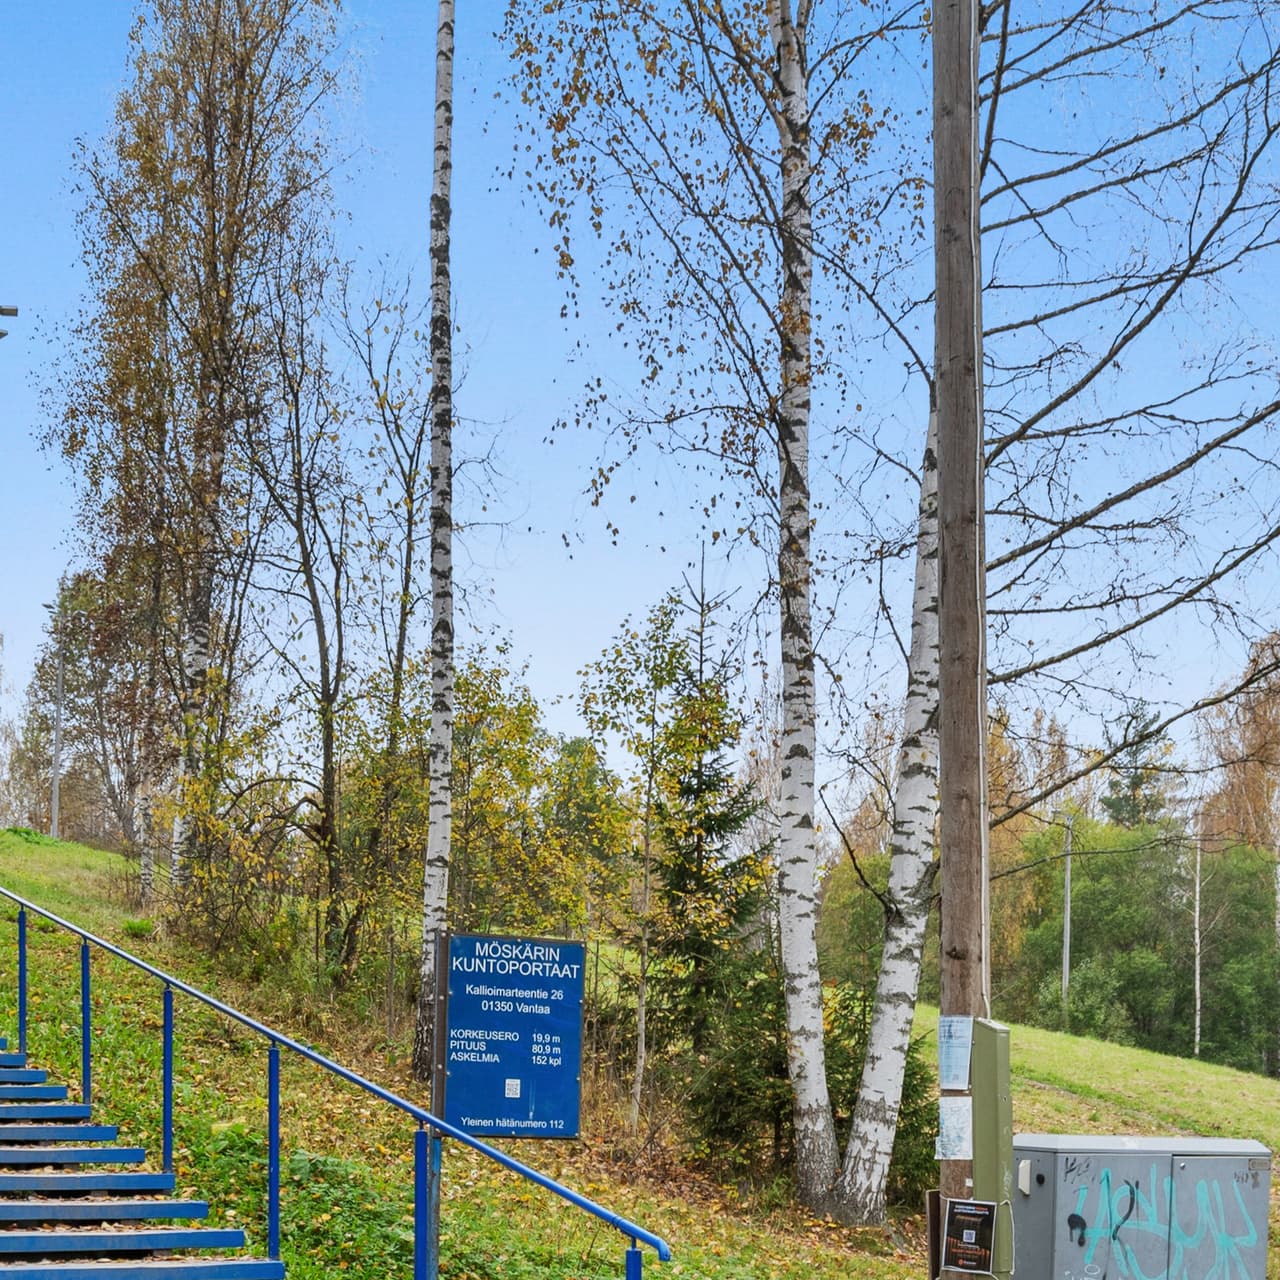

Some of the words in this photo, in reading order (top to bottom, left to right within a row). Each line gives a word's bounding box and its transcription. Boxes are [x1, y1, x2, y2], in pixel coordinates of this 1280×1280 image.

[475, 941, 560, 962] MÖSKÄRIN
[452, 957, 580, 979] KUNTOPORTAAT
[465, 984, 548, 999] Kallioimarteentie
[550, 989, 564, 1000] 26
[481, 1000, 513, 1012] 01350
[515, 1002, 551, 1014] Vantaa
[450, 1029, 520, 1041] KORKEUSERO
[532, 1033, 551, 1043] 19,9
[450, 1040, 486, 1051] PITUUS
[450, 1052, 500, 1063] ASKELMIA
[532, 1056, 547, 1065] 152
[549, 1056, 561, 1067] kpl
[461, 1117, 494, 1127] Yleinen
[495, 1118, 547, 1128] hätänumero
[549, 1120, 564, 1129] 112
